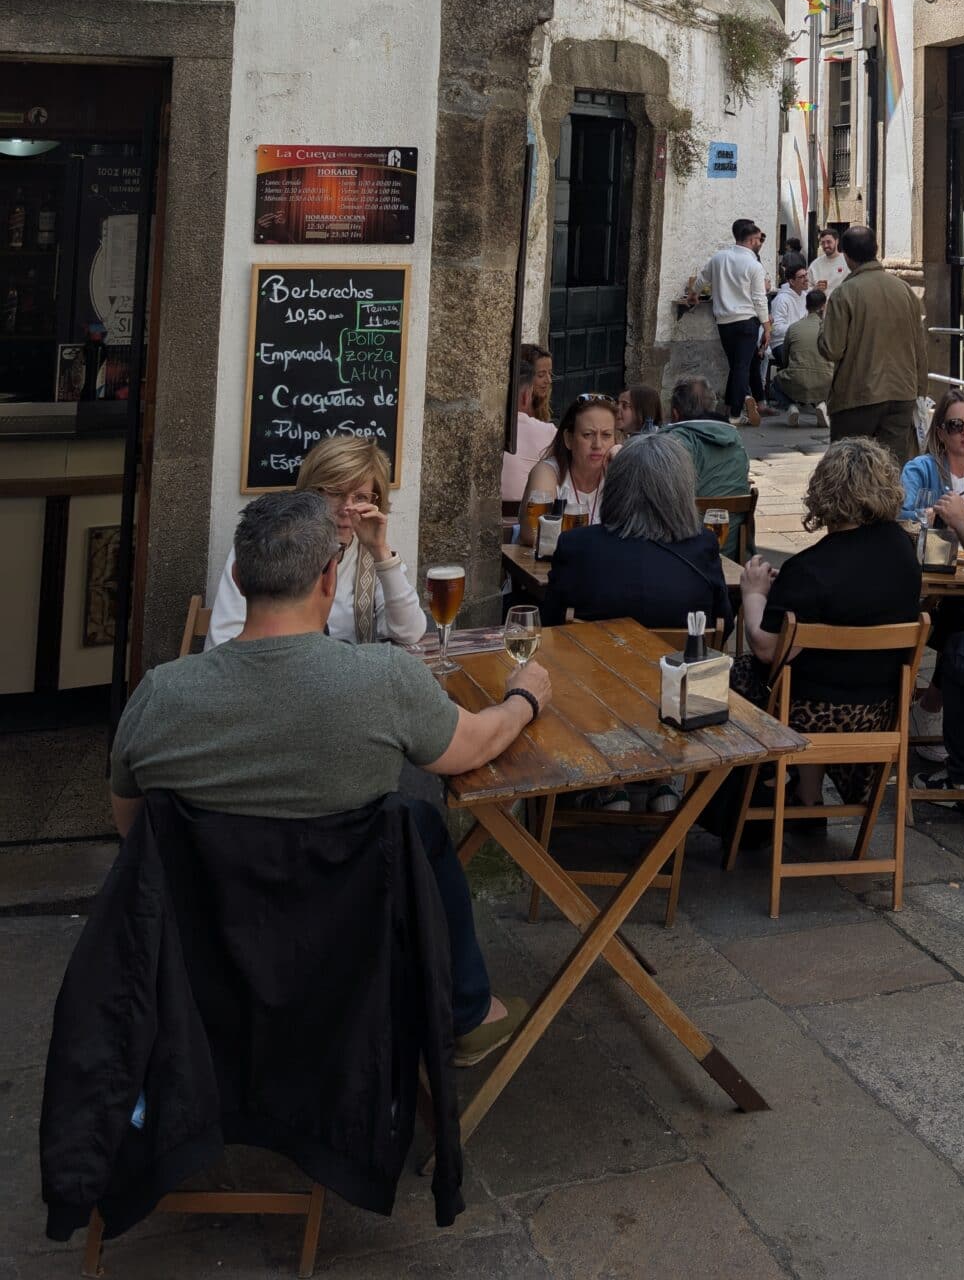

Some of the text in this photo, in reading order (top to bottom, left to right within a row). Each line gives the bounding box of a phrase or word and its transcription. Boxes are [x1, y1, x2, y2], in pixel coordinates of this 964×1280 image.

[276, 150, 291, 158] La
[296, 150, 337, 160] Cueva
[262, 275, 374, 303] Berberechos
[284, 308, 327, 324] 10,50
[364, 316, 383, 327] 11
[346, 331, 386, 346] Pollo
[260, 341, 333, 372] Empanada
[271, 384, 366, 413] Croquetas
[271, 420, 321, 449] Pulpo
